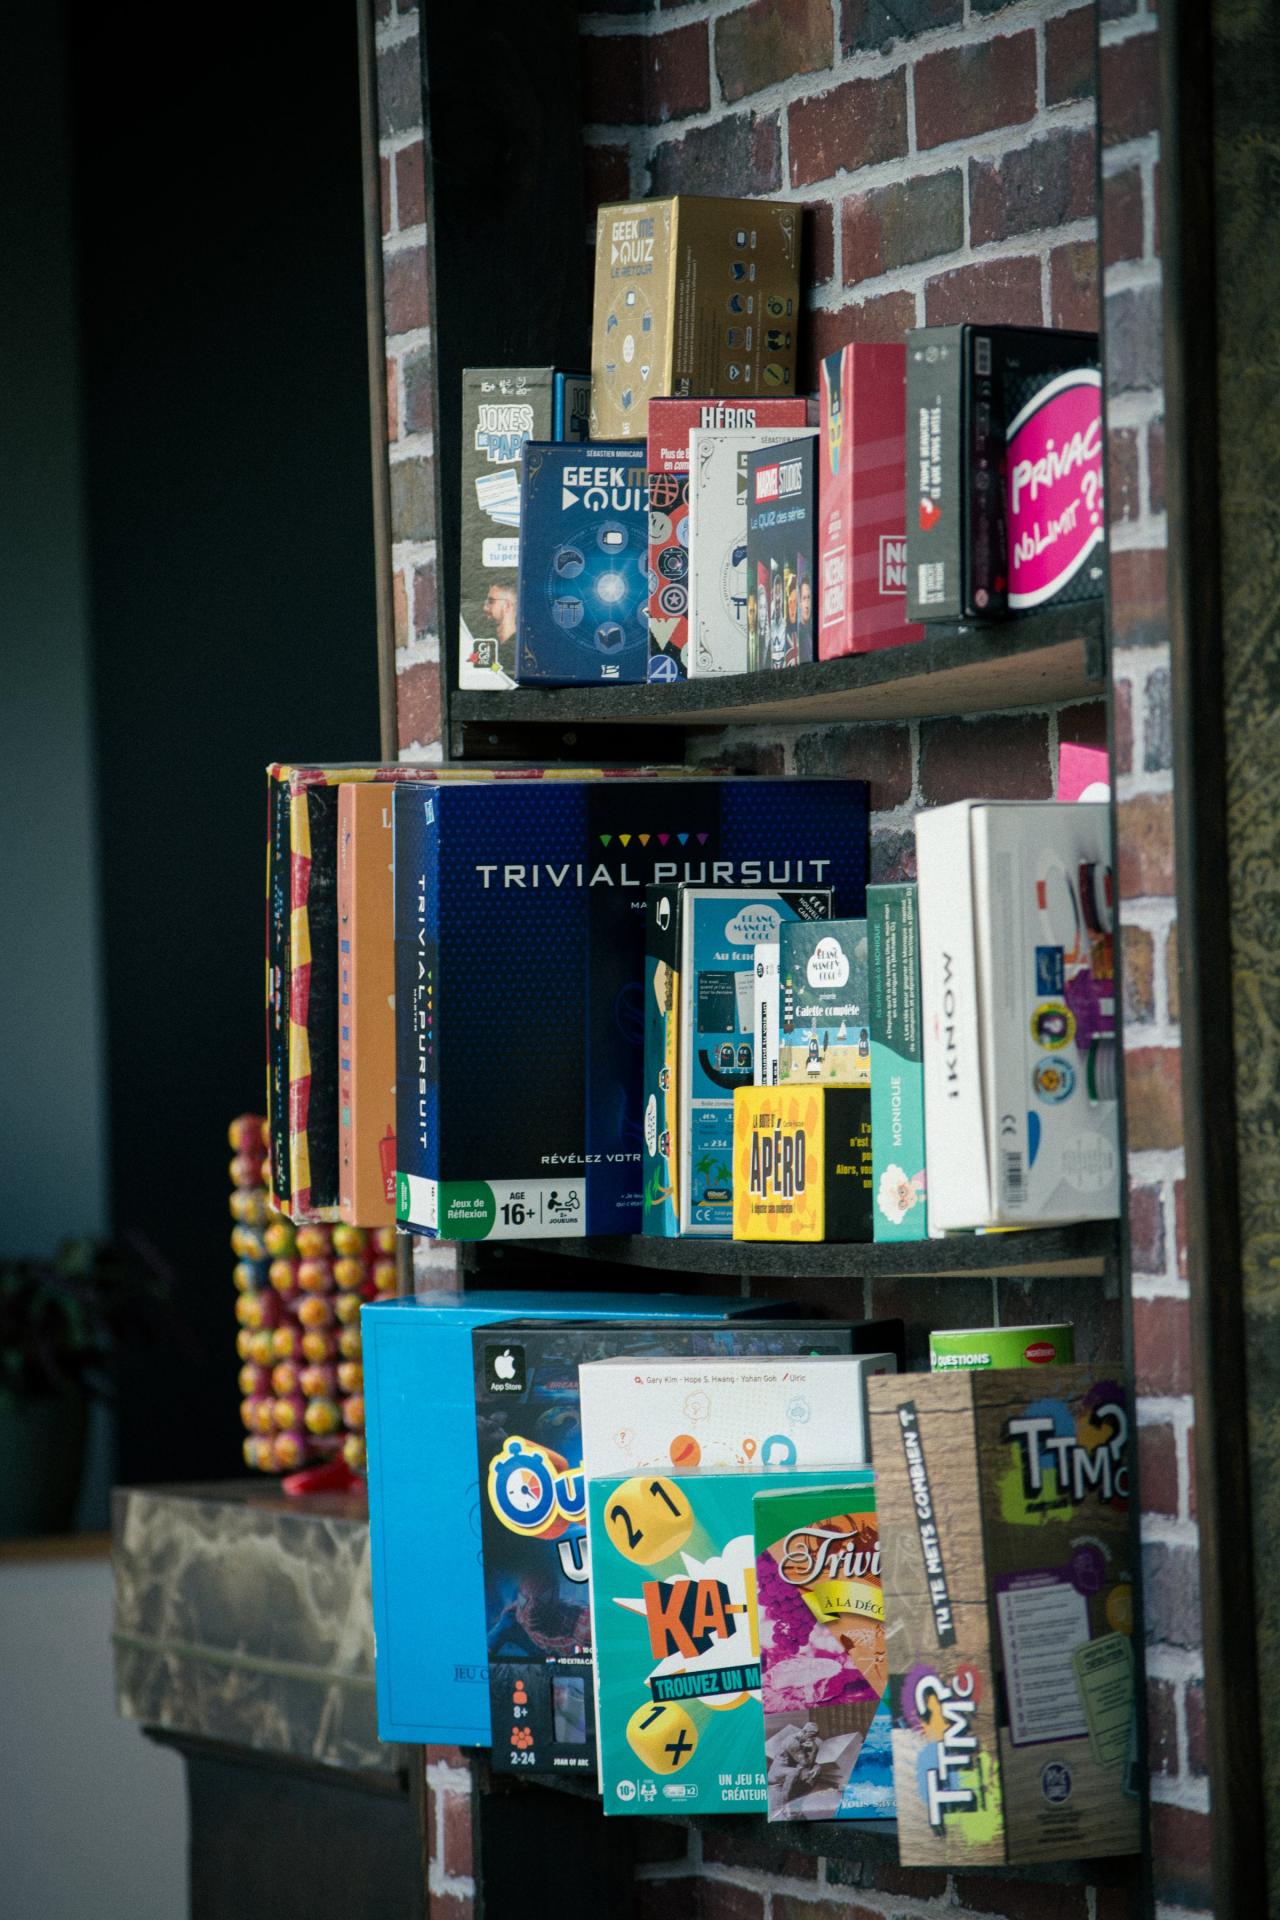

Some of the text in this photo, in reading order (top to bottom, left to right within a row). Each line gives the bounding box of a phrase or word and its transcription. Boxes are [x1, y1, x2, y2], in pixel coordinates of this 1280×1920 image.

[613, 220, 640, 241] GEEK
[621, 239, 655, 265] QUIZ
[480, 406, 533, 432] JOKES
[702, 400, 757, 428] HÉROS
[661, 448, 675, 459] Plus
[677, 448, 684, 459] de
[563, 467, 625, 487] GEEK
[475, 859, 831, 889] TRIVIAL PURSUIT
[713, 952, 729, 961] Au
[418, 874, 428, 1149] TRIVIAL PURSUIT
[796, 1005, 823, 1017] Galette
[891, 1076, 902, 1148] MONIQUE
[542, 1153, 642, 1165] RÉVÉLEZ VOTR
[750, 1118, 806, 1198] APÉRO
[836, 1164, 859, 1176] Alors,
[510, 1191, 525, 1200] AGE
[451, 1198, 484, 1209] Jeux de
[448, 1209, 487, 1220] Réflexion
[501, 1203, 535, 1225] 16+
[938, 1353, 990, 1367] QUESTIONS
[646, 1376, 663, 1385] Gary
[684, 1376, 701, 1386] Hope
[711, 1375, 735, 1385] Hwang
[741, 1375, 759, 1383] Yohan
[790, 1374, 806, 1382] Ulric
[491, 1382, 522, 1392] App Store
[904, 1431, 953, 1635] TU TE METS COMBIEN
[778, 1527, 881, 1585] Trivi
[837, 1596, 851, 1607] LA
[454, 1666, 475, 1681] JEU
[655, 1667, 760, 1700] TROUVEZ UN M
[513, 1706, 528, 1718] 8+
[510, 1752, 536, 1765] 2-24
[719, 1774, 766, 1785] UN JEU FA
[721, 1787, 768, 1801] CRÉATEUR
